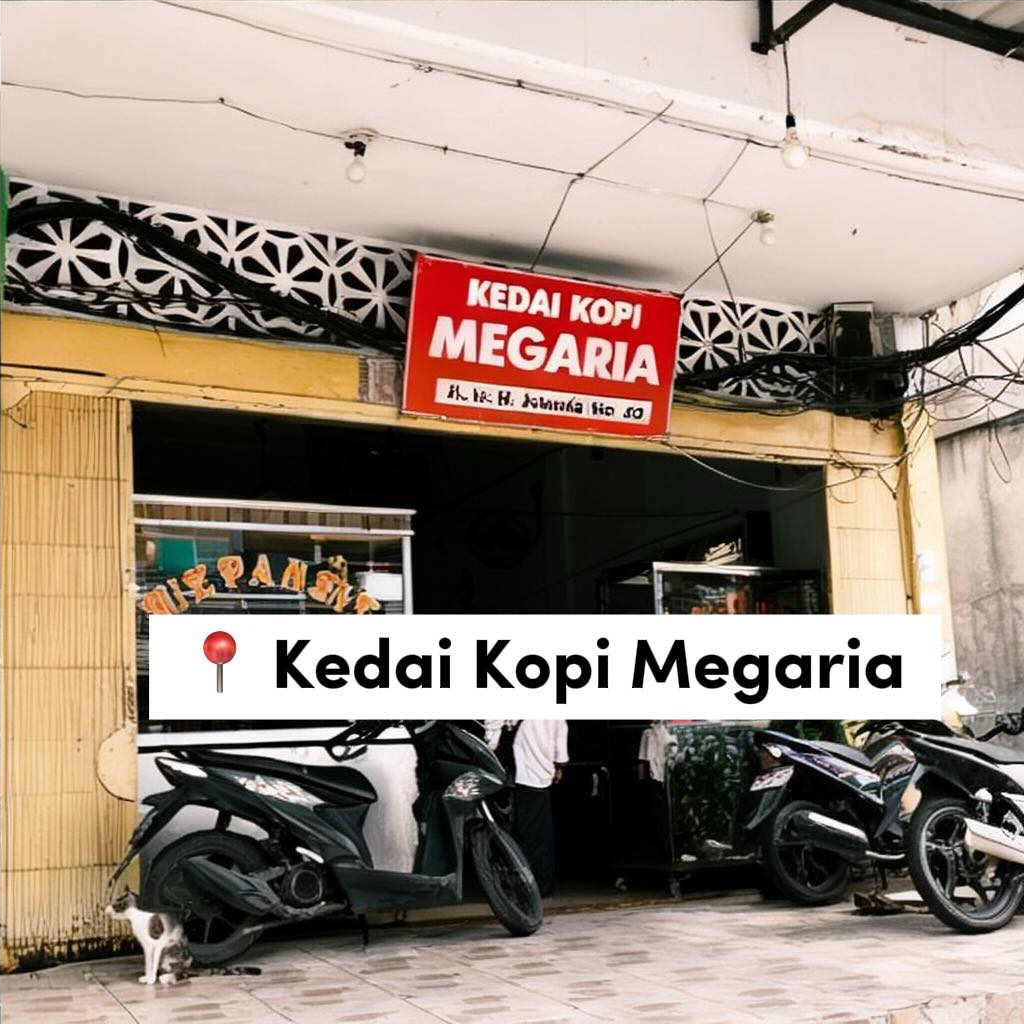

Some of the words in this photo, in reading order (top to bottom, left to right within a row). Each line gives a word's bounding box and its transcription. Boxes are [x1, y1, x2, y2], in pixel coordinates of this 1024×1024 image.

[466, 277, 562, 318] KEDAI
[569, 293, 642, 330] KOPI
[428, 315, 661, 386] MEGARIA
